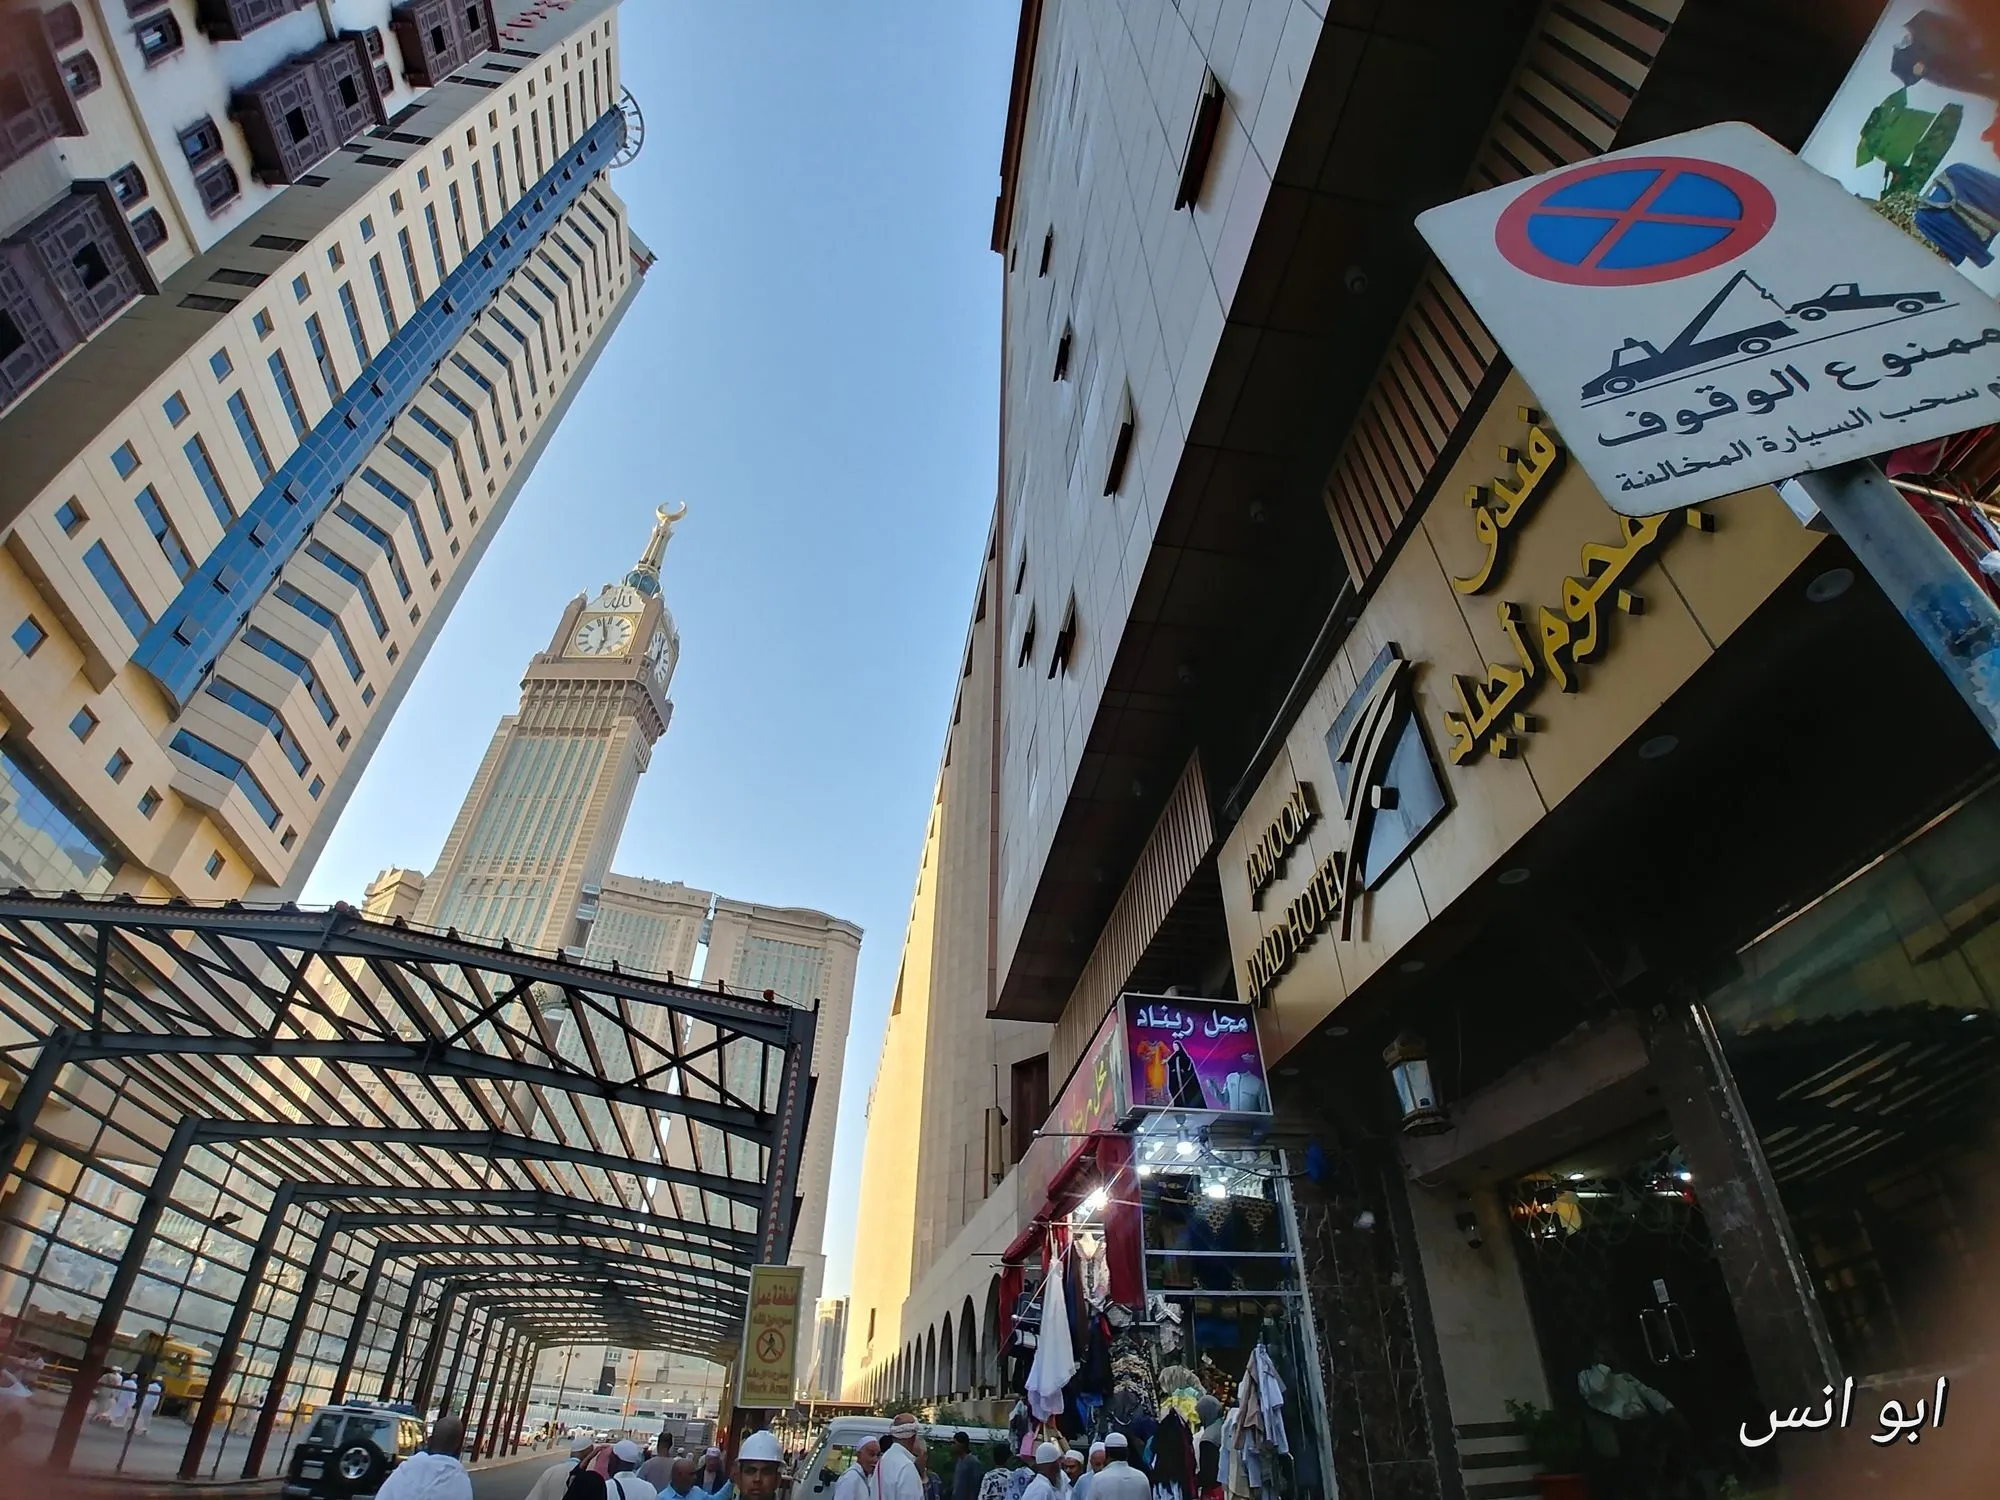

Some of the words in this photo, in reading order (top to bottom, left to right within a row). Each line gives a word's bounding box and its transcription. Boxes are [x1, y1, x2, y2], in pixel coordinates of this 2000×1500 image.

[1825, 328, 2000, 391] ممنوع
[1598, 364, 1810, 447] الوقوف
[1756, 406, 1873, 453] السيارة
[1879, 388, 1979, 423] سحب
[1615, 439, 1752, 492] المخالفة
[1453, 405, 1560, 594] فندق
[1444, 601, 1535, 766] أجياد
[1245, 782, 1312, 895] AMJOOM
[1136, 1004, 1194, 1039] ريناد
[1204, 1008, 1249, 1038] محل
